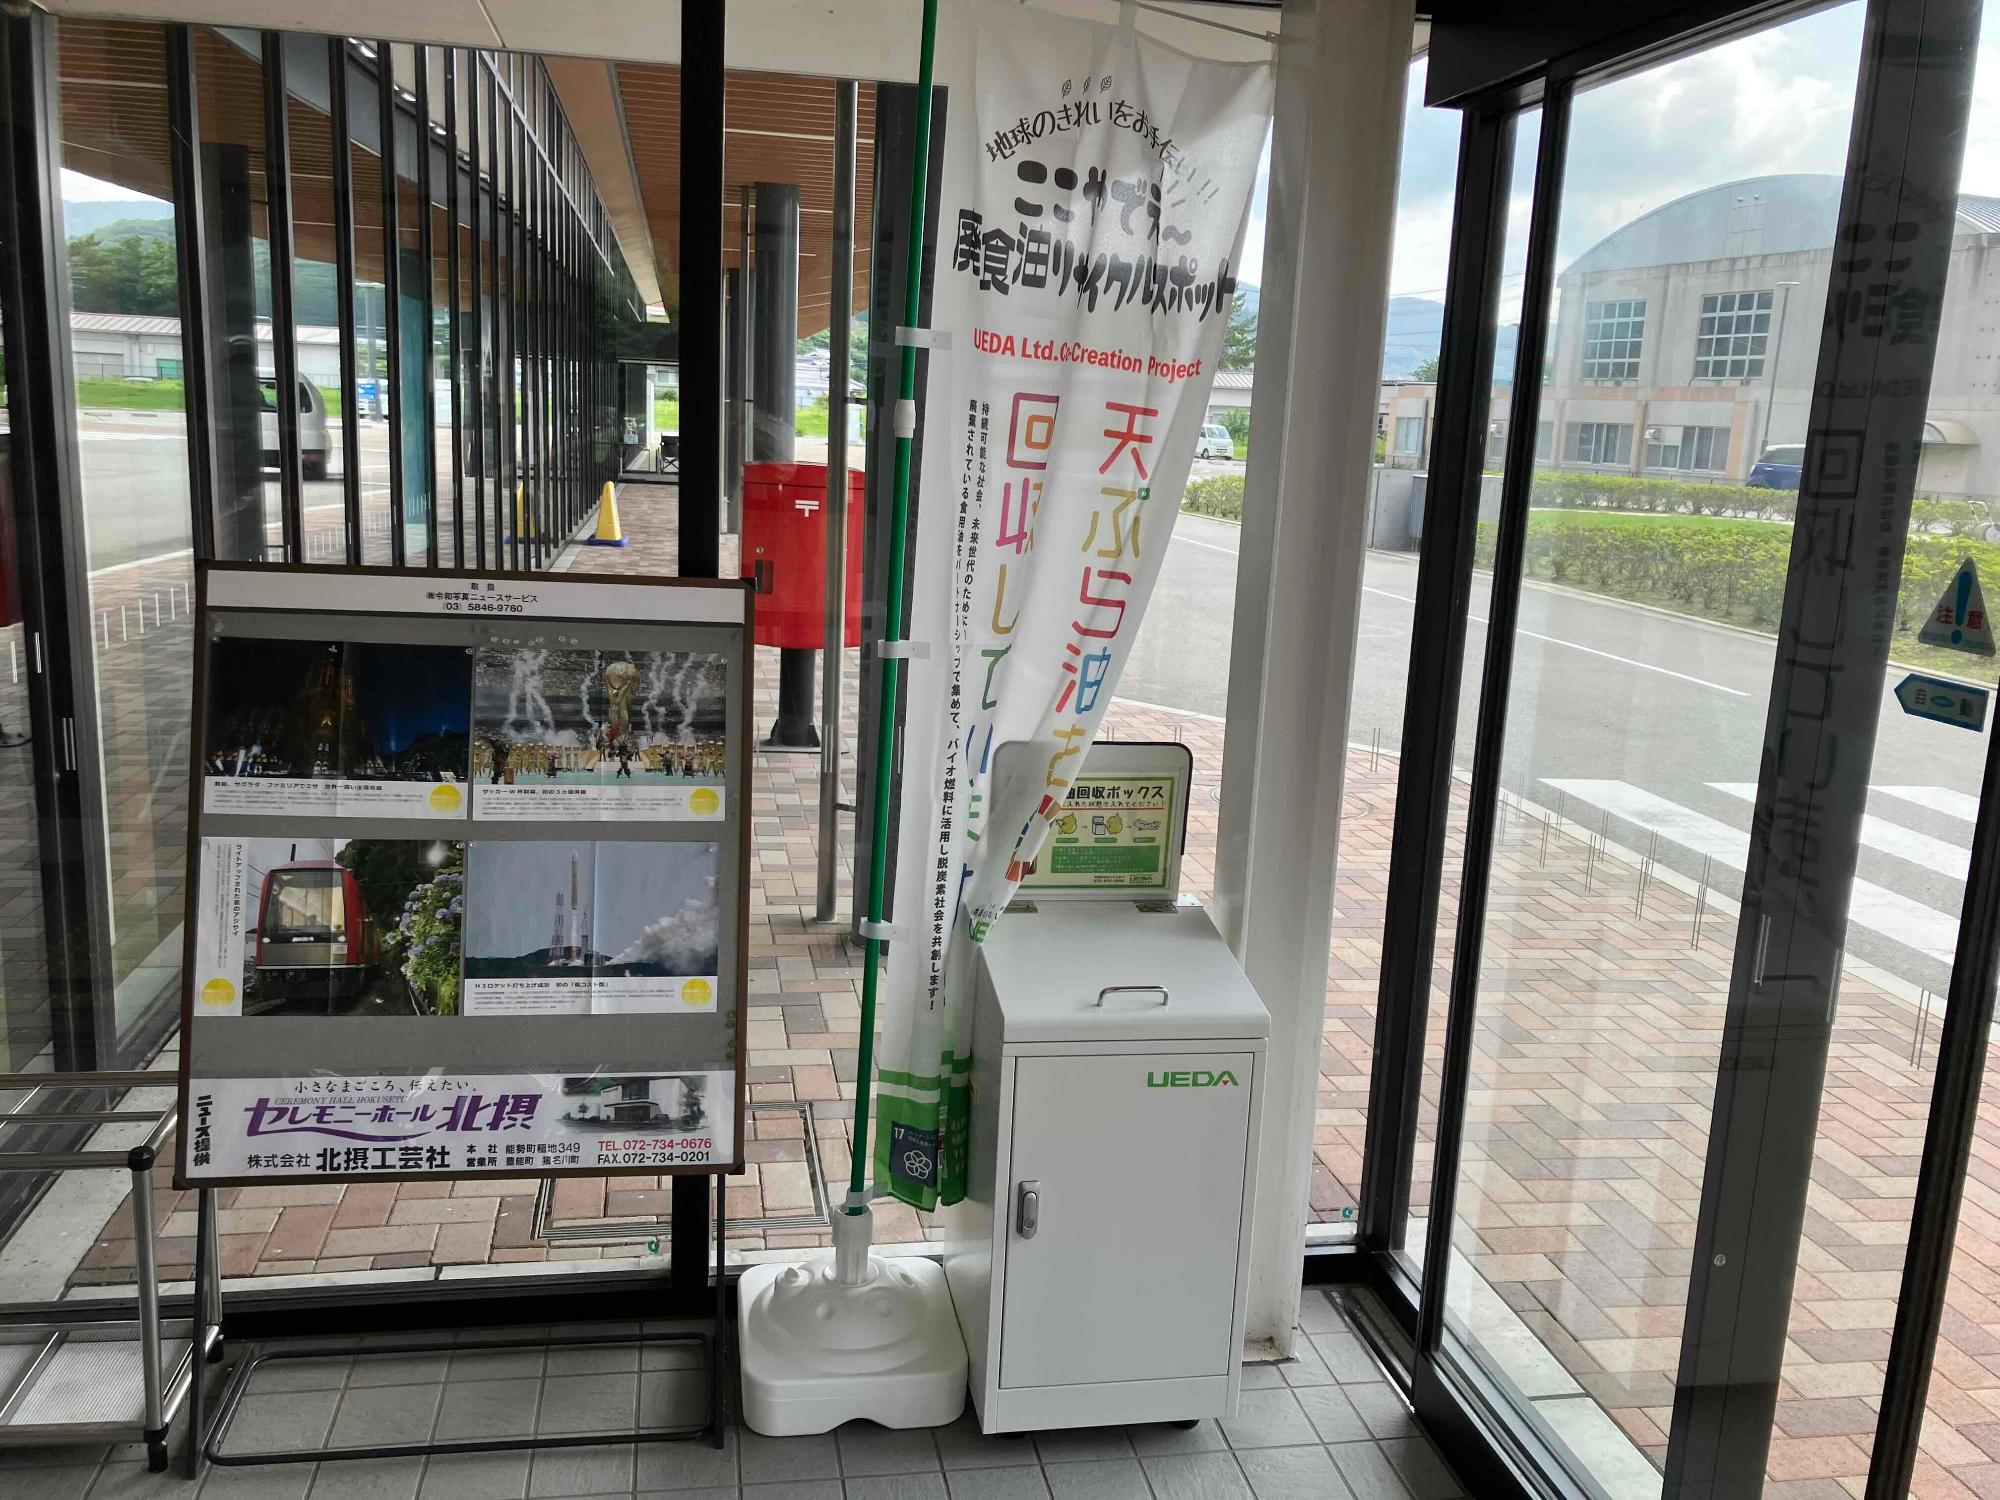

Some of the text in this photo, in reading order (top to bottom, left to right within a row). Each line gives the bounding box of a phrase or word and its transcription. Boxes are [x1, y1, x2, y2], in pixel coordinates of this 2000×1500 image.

[973, 327, 1015, 357] UEDA
[1147, 355, 1202, 384] Project
[467, 603, 523, 613] 5846-9760
[294, 1079, 478, 1094] 小さなまごころ、伝えたい。
[1147, 1070, 1239, 1088] UEDA
[193, 1094, 212, 1167] ニュース提供
[893, 1127, 905, 1141] 17
[598, 1137, 712, 1151] TEL.072-734-0676
[247, 1145, 451, 1172] 株式会社 北摂工芸社
[466, 1156, 498, 1168] 営業所
[597, 1150, 711, 1165] FAX.072-734-0201
